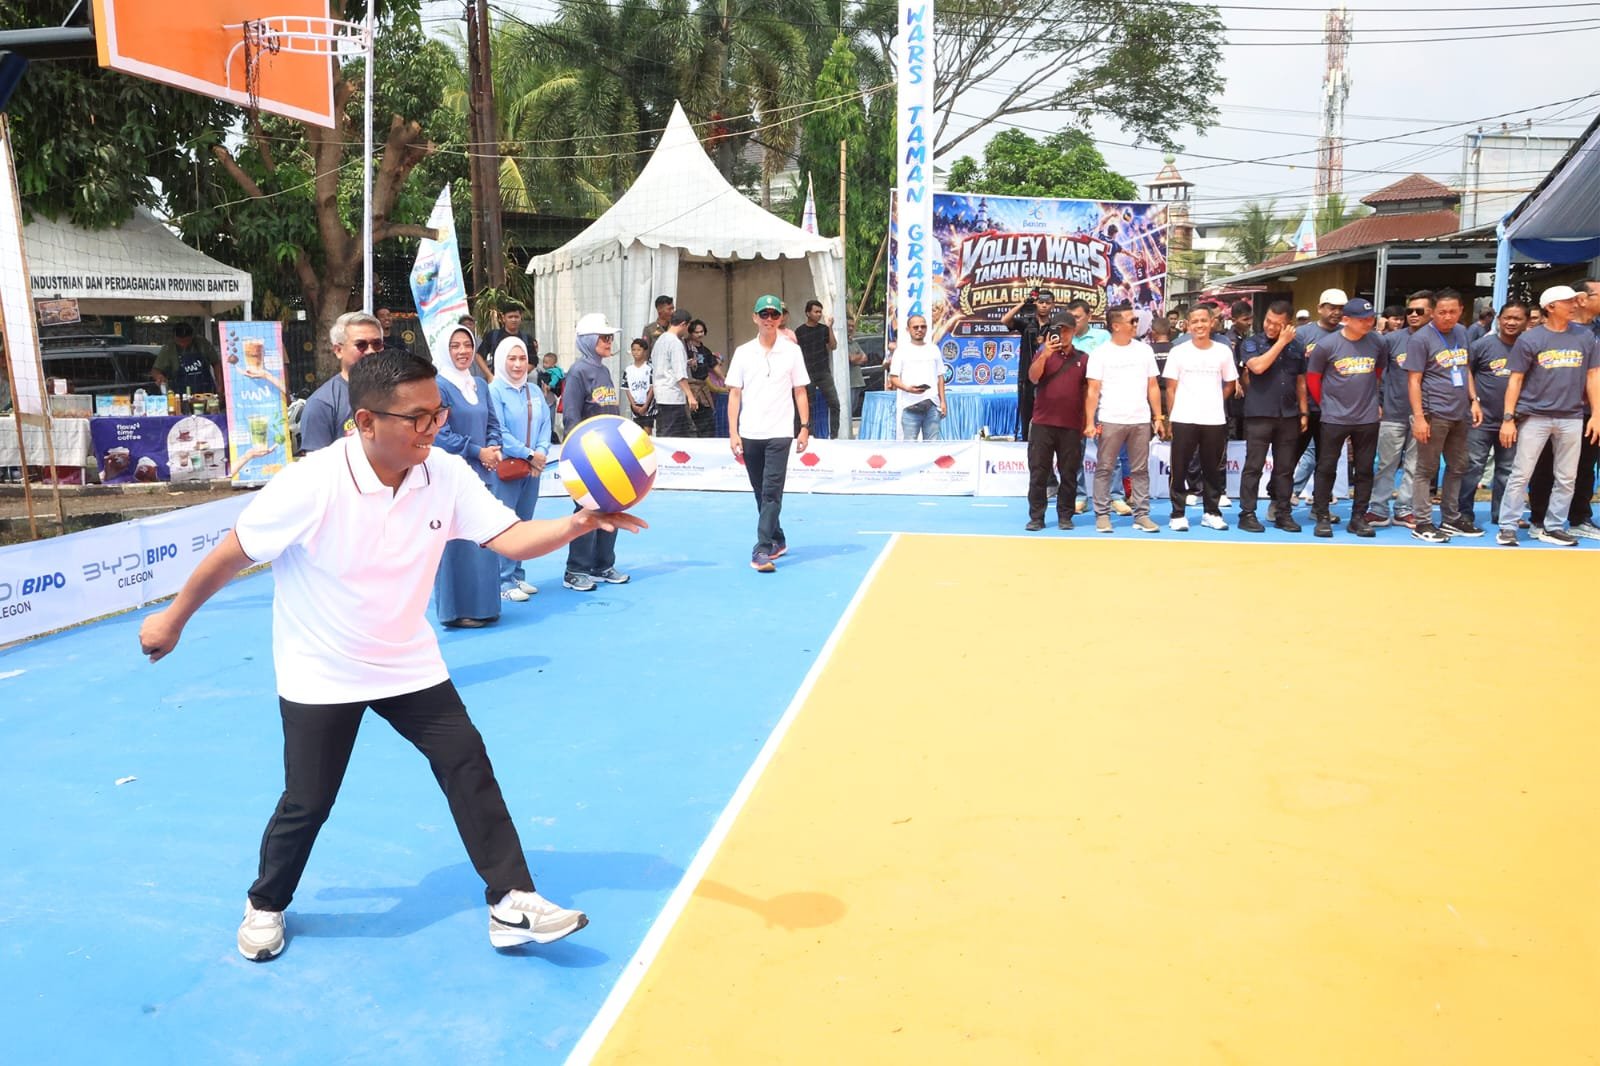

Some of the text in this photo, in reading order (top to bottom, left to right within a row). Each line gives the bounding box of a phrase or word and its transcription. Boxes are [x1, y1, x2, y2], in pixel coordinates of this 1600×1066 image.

[906, 5, 925, 317] WARS TAMAN GRAHA
[961, 235, 1107, 281] VOLLEY WARS
[30, 275, 239, 292] INDUSTRIAN DAN PERDAGANGAN PROVINSI BANTEN
[974, 261, 1093, 286] TAMAN GRAHA ASRI
[973, 288, 1010, 307] PIALA
[998, 461, 1026, 471] BANK
[146, 543, 178, 566] BIPO
[22, 571, 66, 596] BIPO
[118, 569, 154, 589] CILEGON
